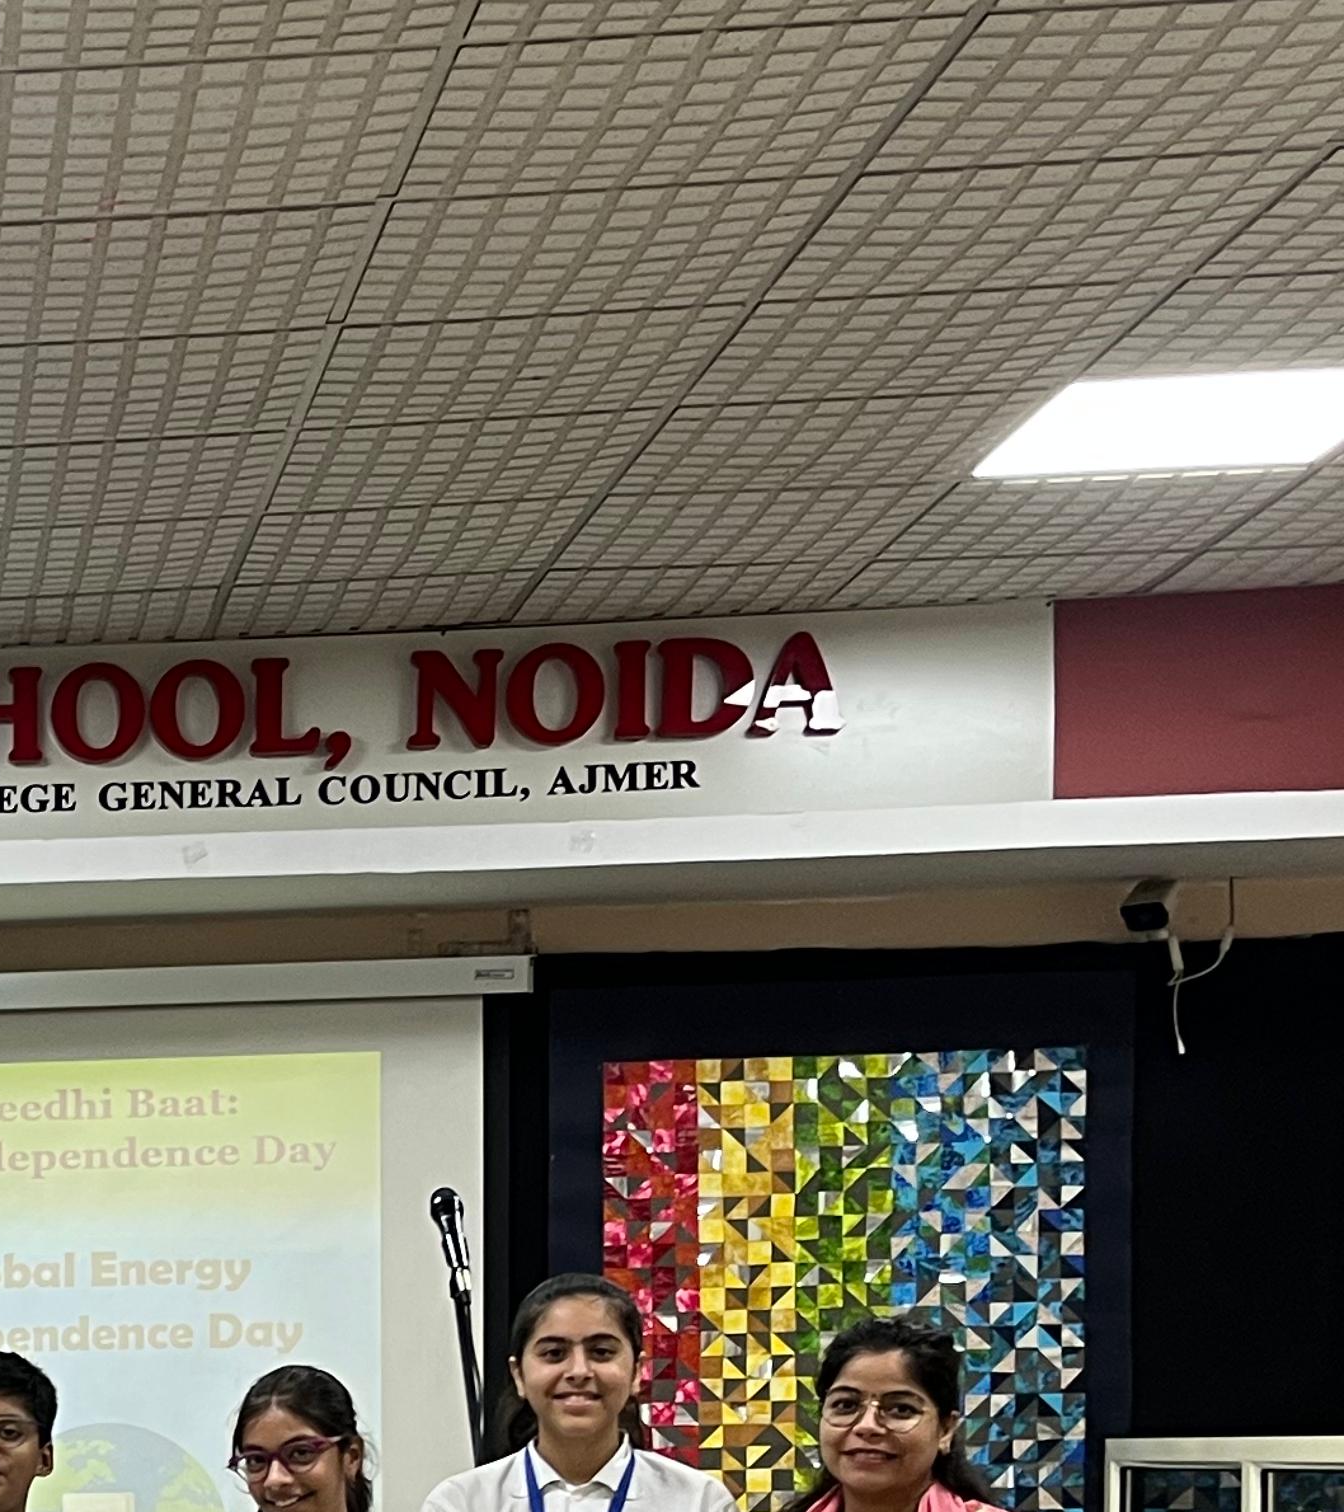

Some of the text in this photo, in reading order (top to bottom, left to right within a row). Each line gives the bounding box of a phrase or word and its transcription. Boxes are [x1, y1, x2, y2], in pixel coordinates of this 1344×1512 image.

[406, 631, 846, 749] NOIDA
[99, 777, 302, 812] GENERAL
[318, 767, 531, 806] COUNCIL,
[547, 760, 701, 797] AJMER
[126, 1088, 239, 1119] Baat:
[252, 1134, 337, 1170] Day
[90, 1251, 252, 1291] Energy
[208, 1312, 304, 1354] Day
